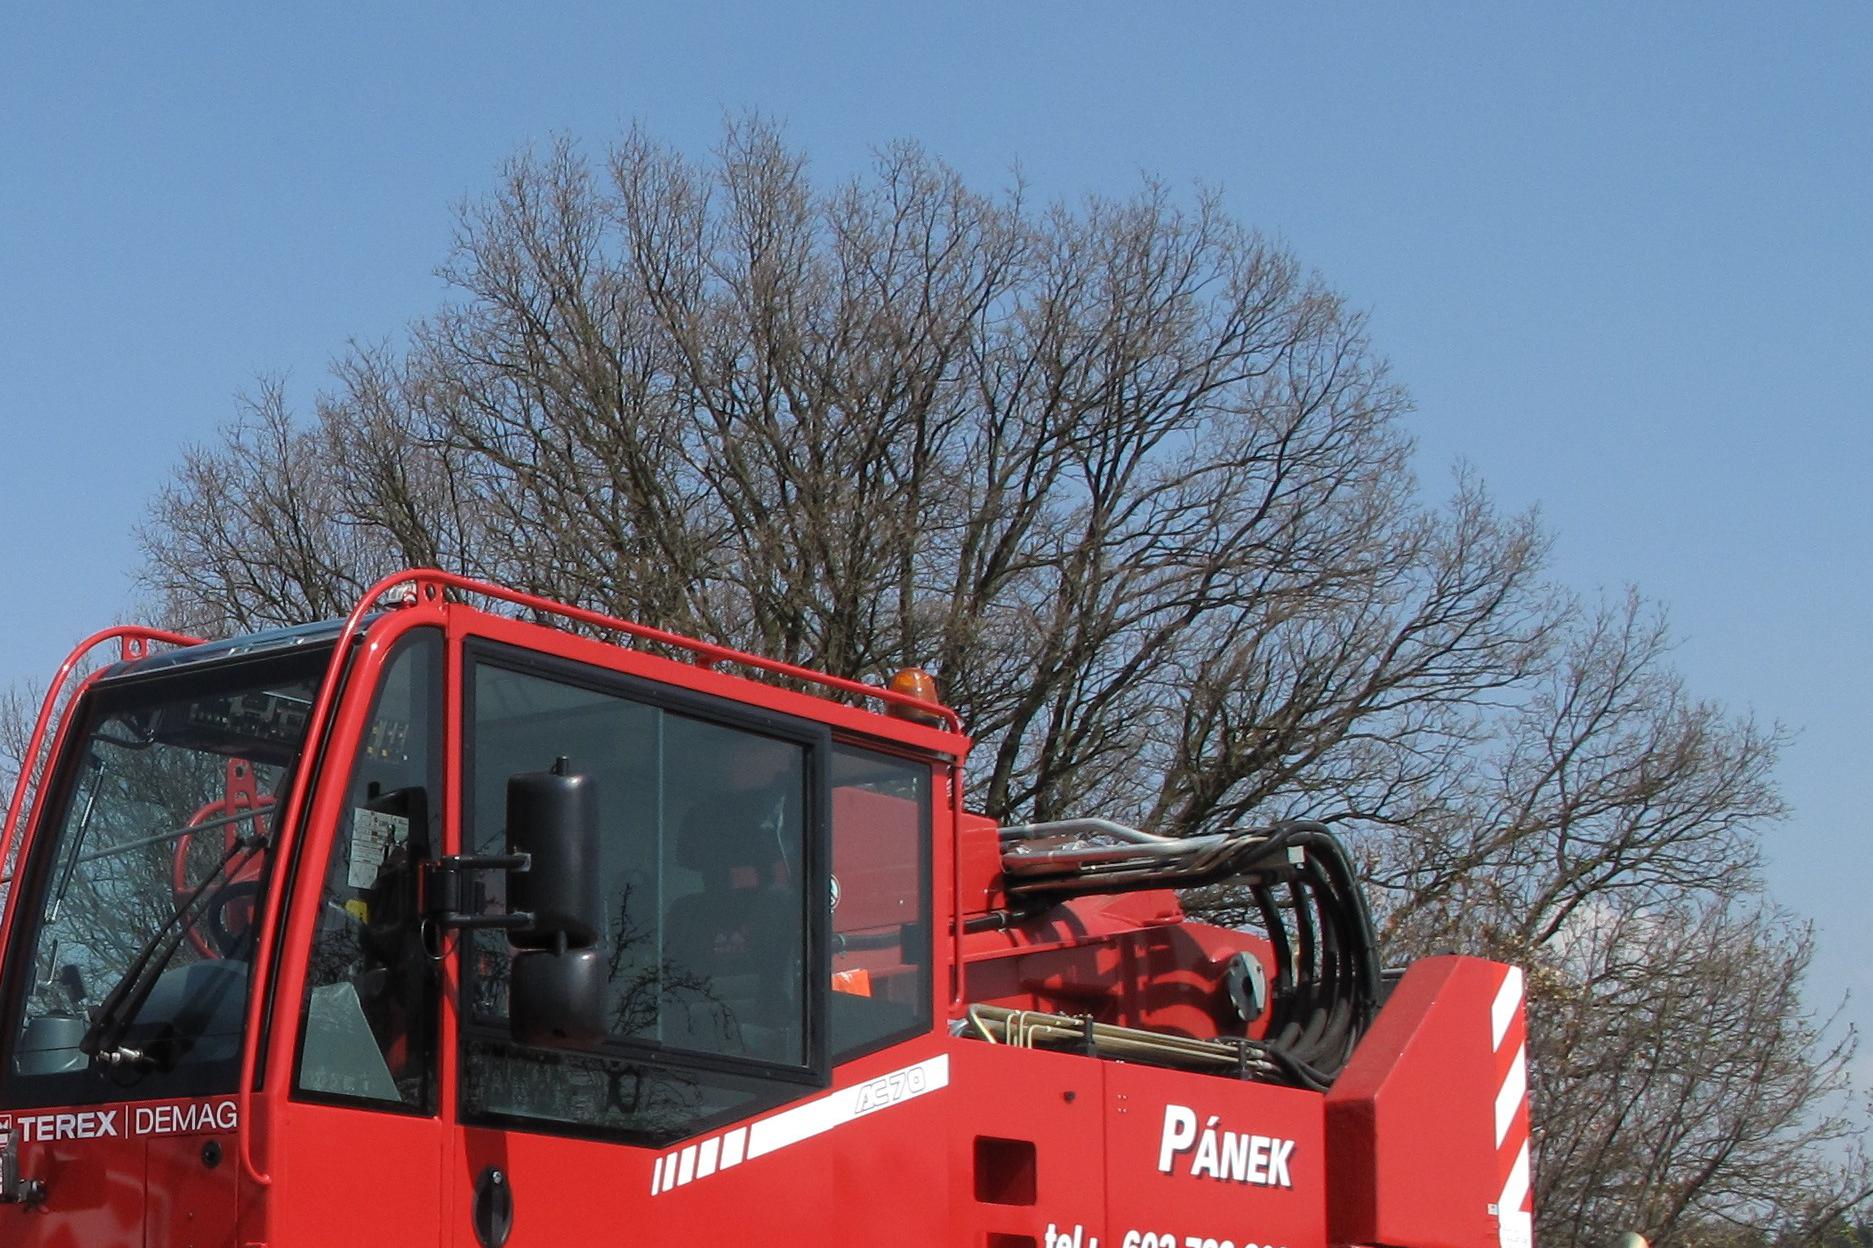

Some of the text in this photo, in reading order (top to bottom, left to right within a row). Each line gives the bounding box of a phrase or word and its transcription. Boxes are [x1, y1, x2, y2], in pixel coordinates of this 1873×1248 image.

[17, 1101, 238, 1142] TEREX DEMAG
[1158, 1103, 1296, 1188] PÁNEK
